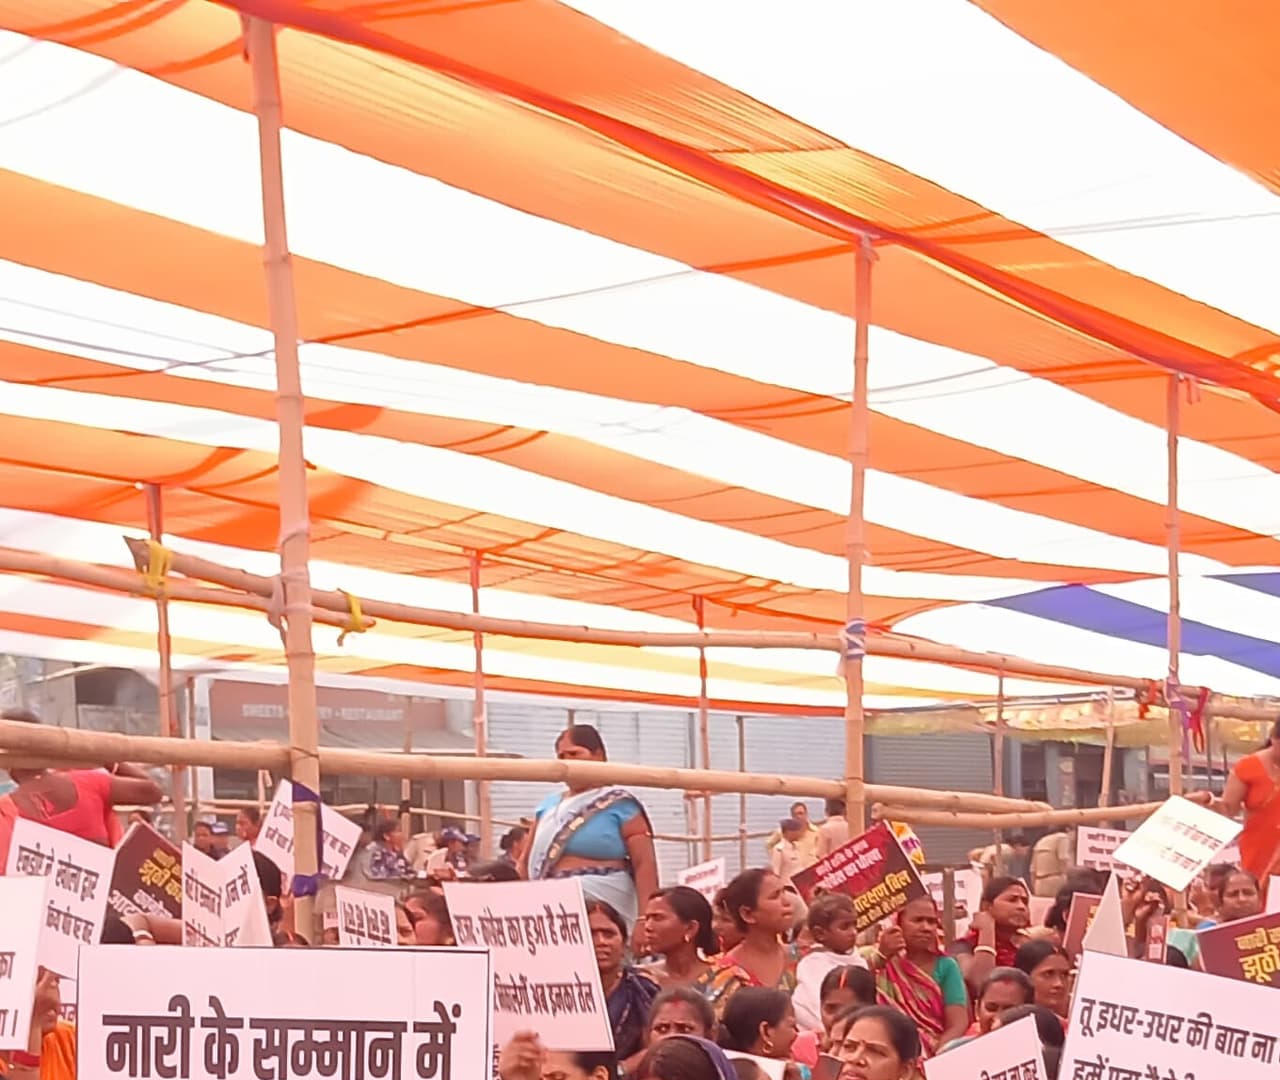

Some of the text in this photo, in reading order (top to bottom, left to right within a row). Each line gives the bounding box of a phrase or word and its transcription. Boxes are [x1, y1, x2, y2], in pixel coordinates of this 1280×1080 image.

[505, 903, 583, 955] का हुआ है मेल
[530, 983, 549, 1012] अब
[546, 983, 578, 1018] इनका
[575, 972, 596, 1013] तेल
[102, 994, 195, 1079] नारी
[201, 995, 244, 1080] के
[1080, 997, 1096, 1037] तू
[1096, 1001, 1184, 1044] इधर-उधर
[1186, 1012, 1212, 1050] की
[1214, 1024, 1250, 1058] बात
[1250, 1033, 1276, 1064] ना
